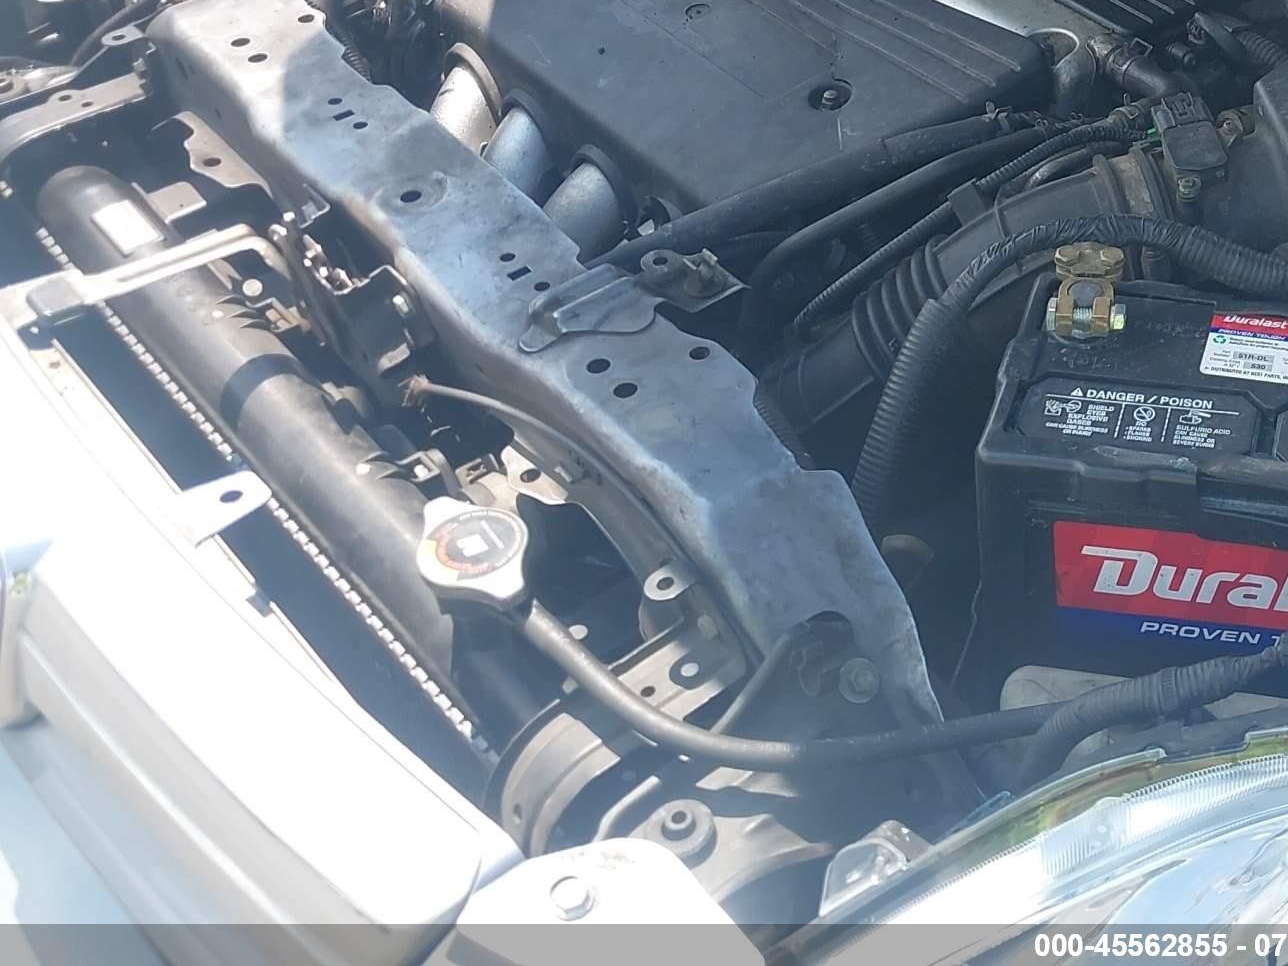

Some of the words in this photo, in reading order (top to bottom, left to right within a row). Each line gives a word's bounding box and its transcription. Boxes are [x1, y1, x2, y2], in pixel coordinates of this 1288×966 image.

[1222, 315, 1288, 330] Duralast
[1086, 388, 1144, 404] DANGER
[1147, 395, 1158, 404] /
[1160, 396, 1213, 410] POISON
[1067, 413, 1109, 422] EXPLOSIVE
[1176, 424, 1213, 434] SULFURIC
[1140, 621, 1261, 645] PROVEN
